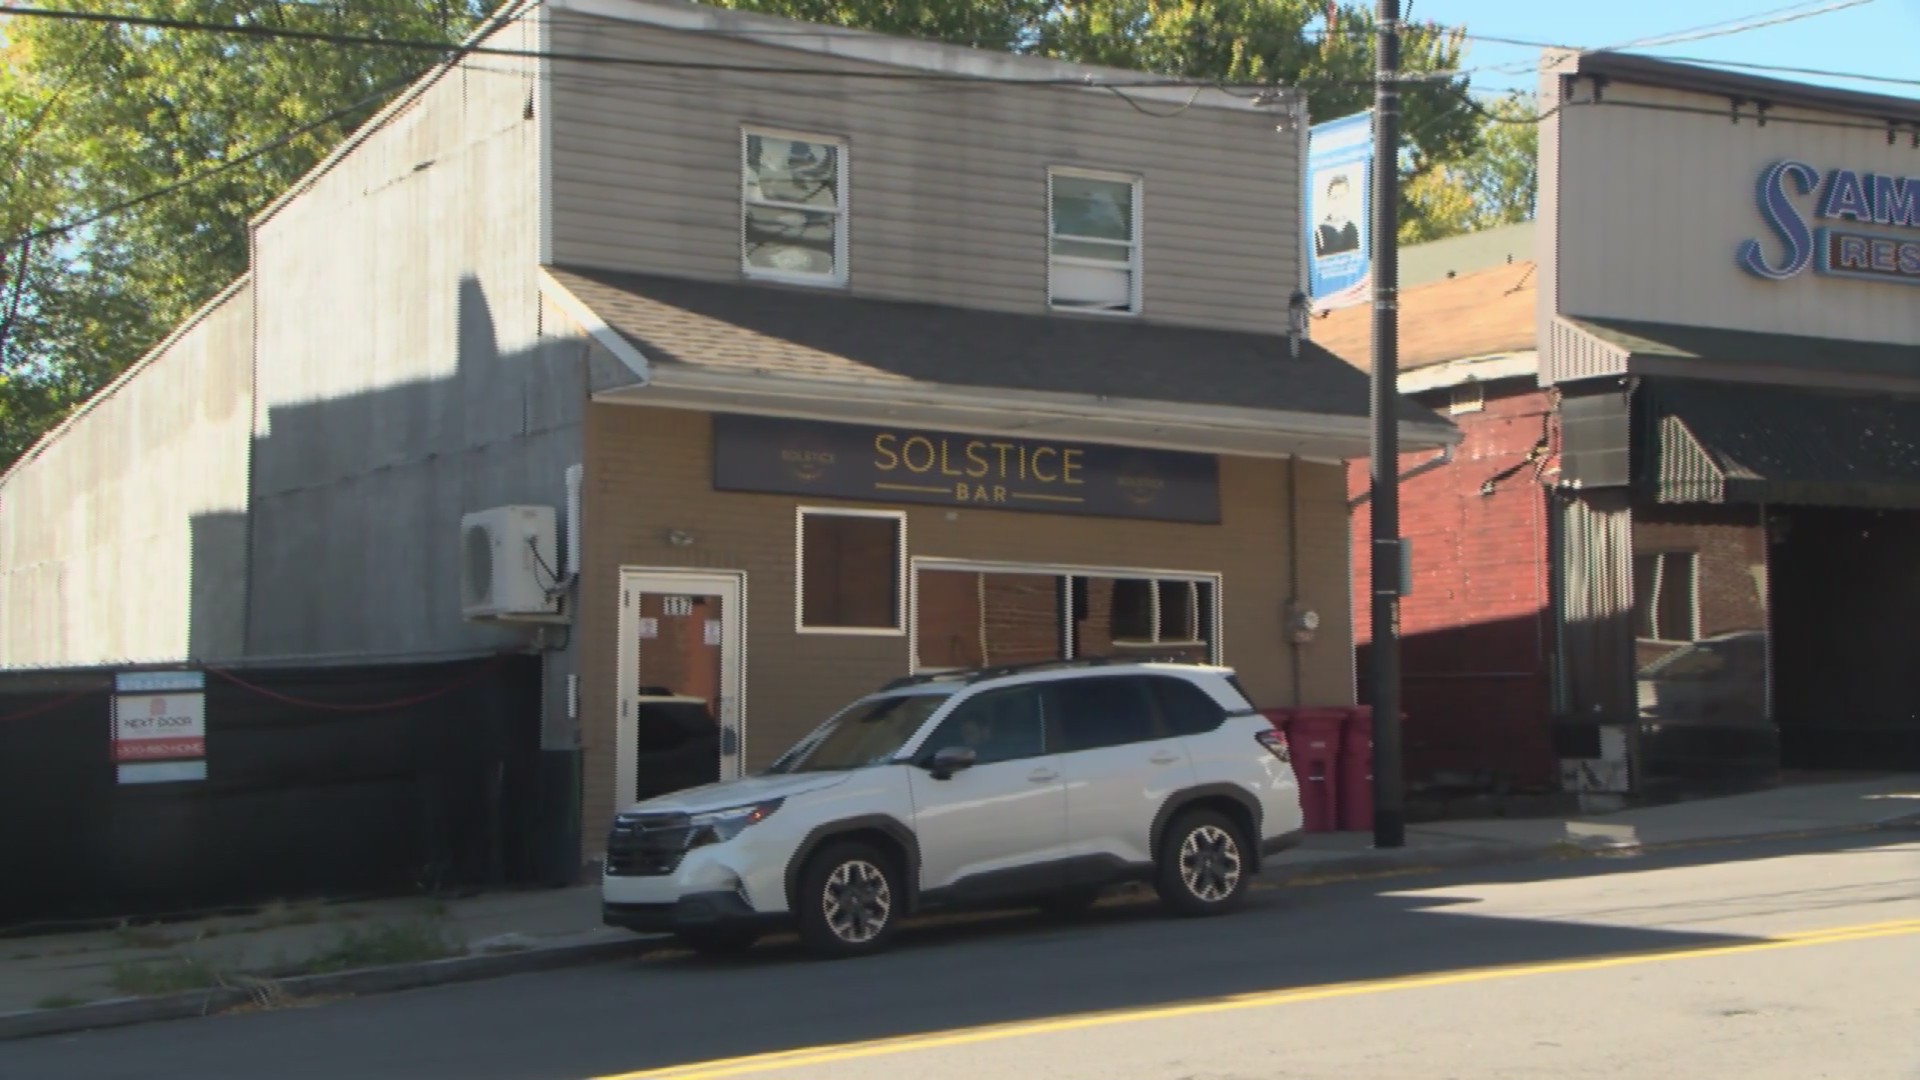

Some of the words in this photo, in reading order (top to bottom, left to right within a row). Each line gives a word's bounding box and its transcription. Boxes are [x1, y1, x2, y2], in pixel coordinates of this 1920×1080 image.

[1737, 160, 1920, 280] SAM
[1840, 236, 1920, 274] RES
[874, 433, 1085, 485] SOLSTICE
[955, 482, 1007, 503] BAR
[123, 717, 155, 728] NEXT
[158, 715, 193, 728] DOOR
